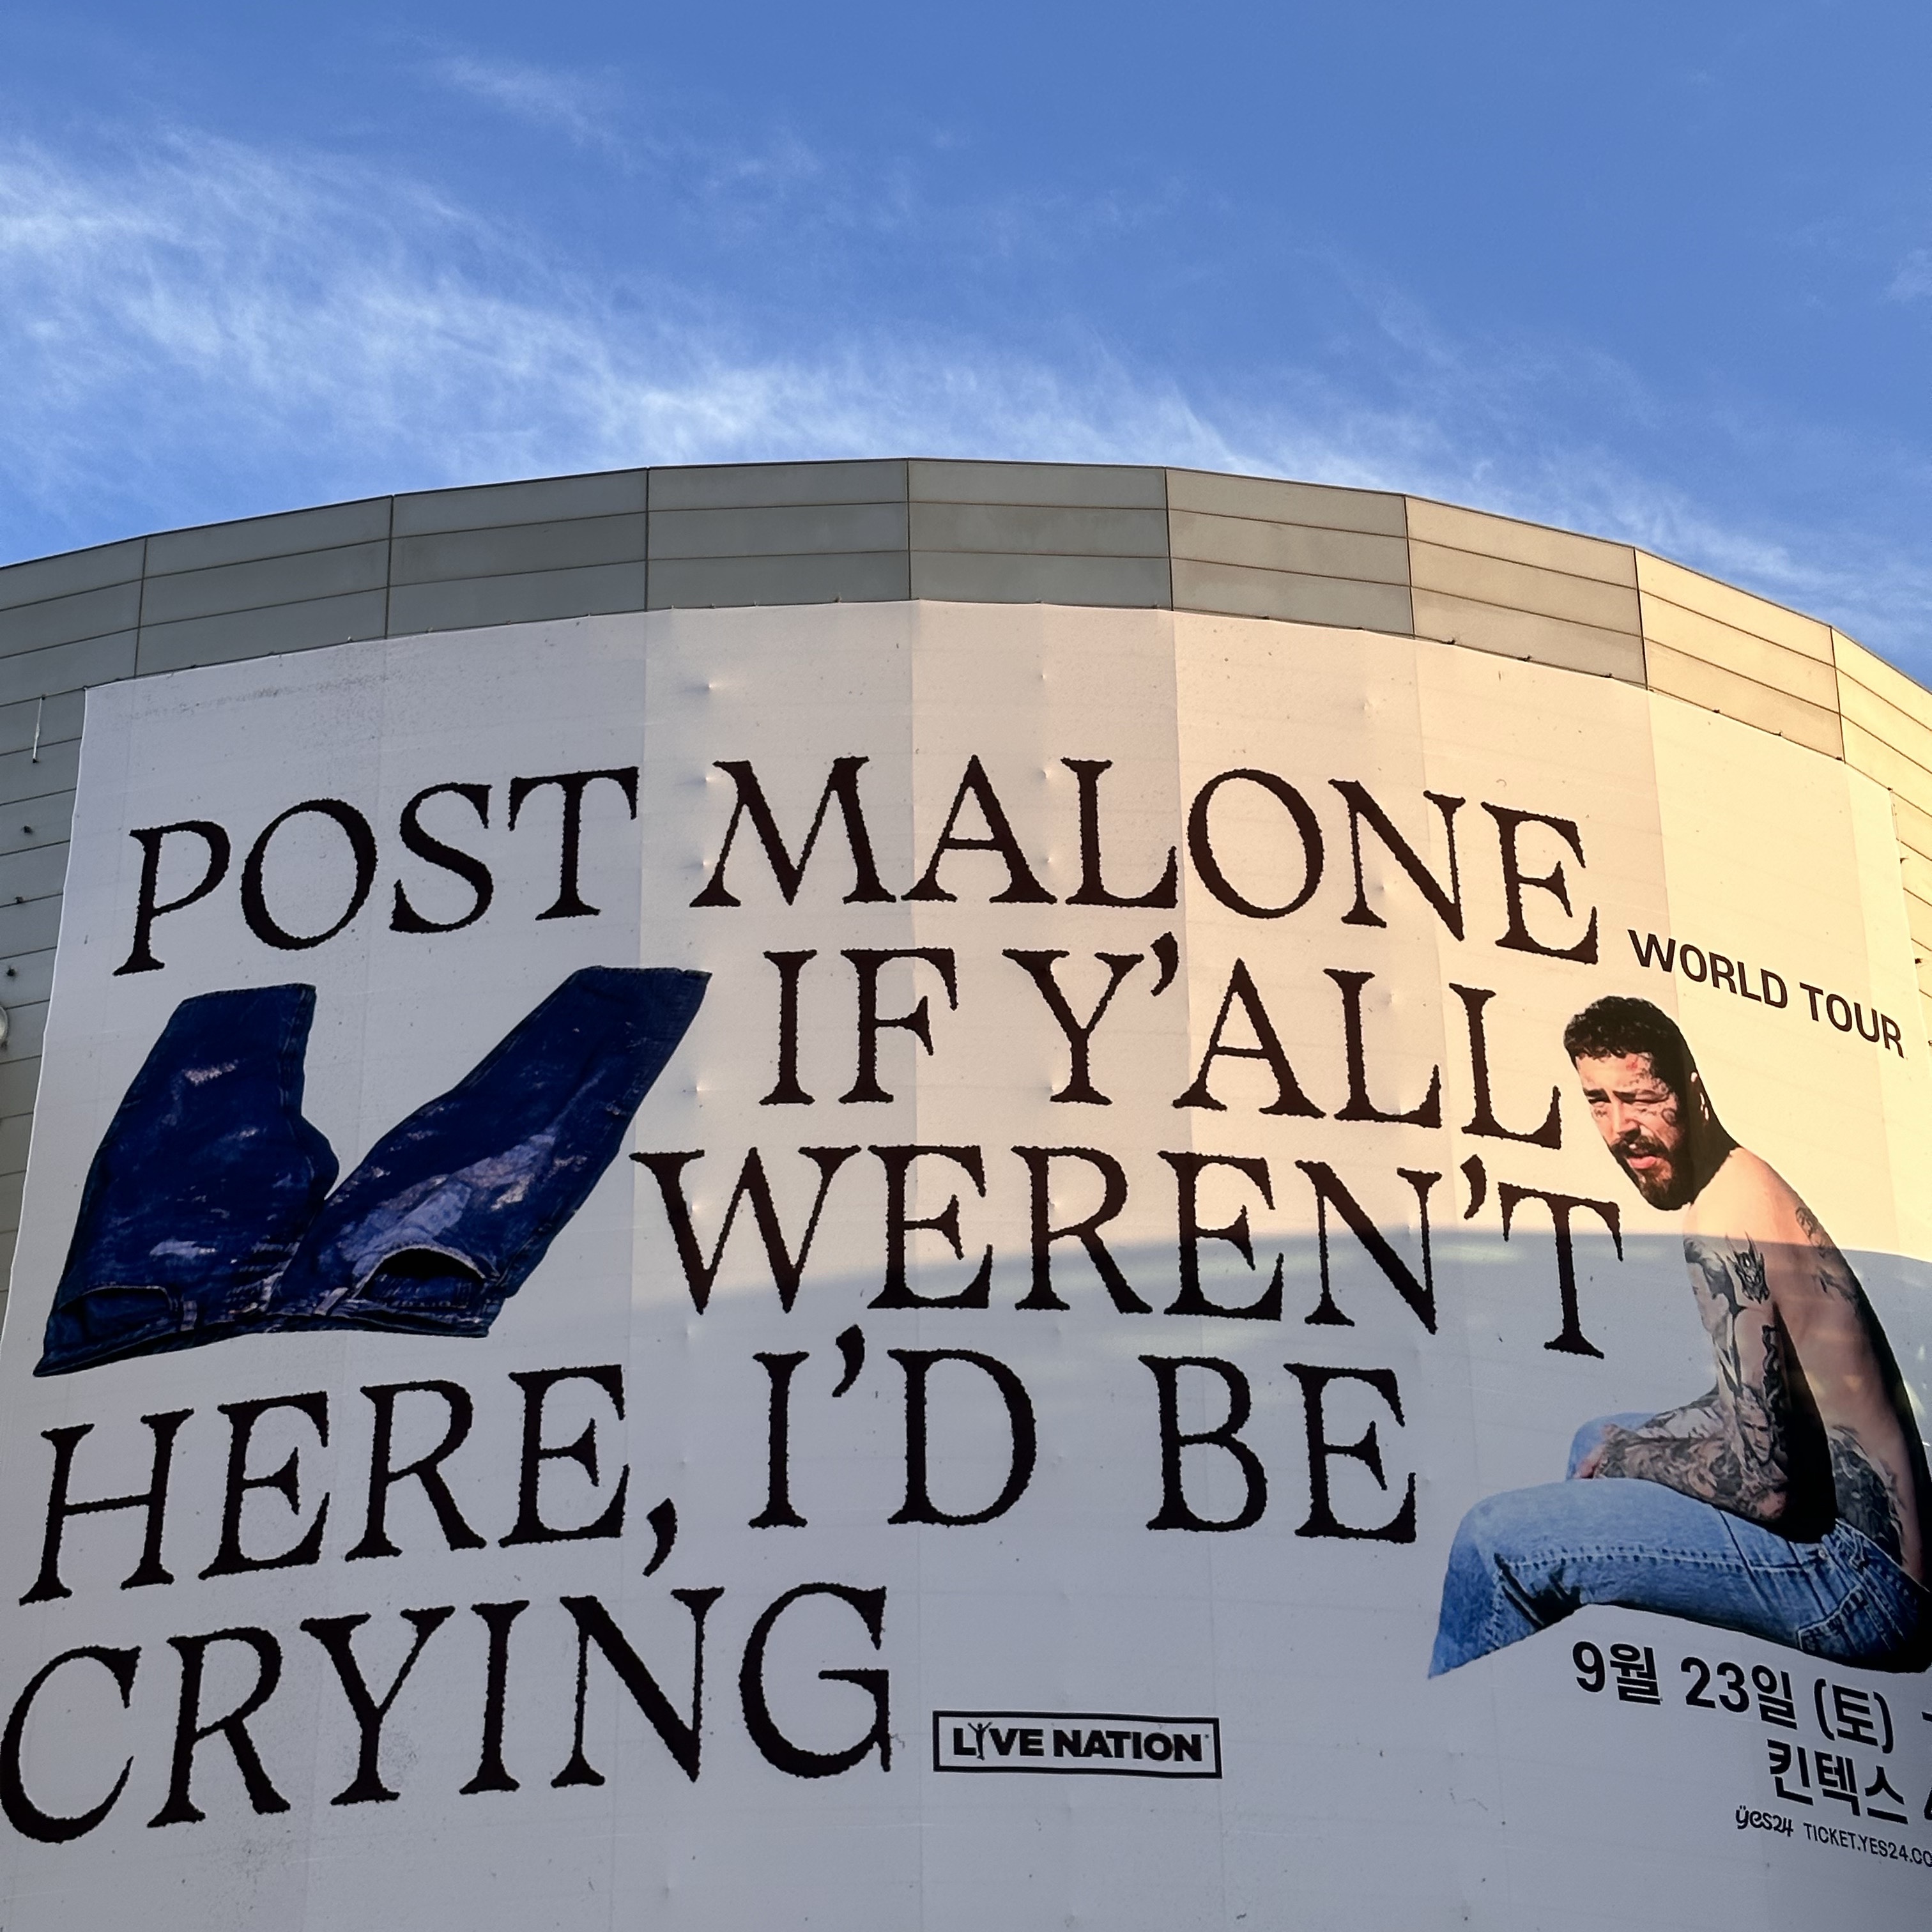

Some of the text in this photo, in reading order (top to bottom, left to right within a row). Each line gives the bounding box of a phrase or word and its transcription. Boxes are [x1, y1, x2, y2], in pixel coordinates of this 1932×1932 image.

[112, 755, 1598, 976] POST MALONE
[758, 931, 1562, 1149] IF Y'ALL
[1627, 929, 1905, 1059] WORLD TOUR
[629, 1144, 1623, 1359] WEREN'T
[19, 1324, 1416, 1606] HERE, I'D BE
[0, 1582, 893, 1844] CRYING
[953, 1722, 1203, 1762] LIVE NATION
[1572, 1641, 1894, 1754] 9월 23일 (토)
[1767, 1738, 1909, 1825] 킨텍스
